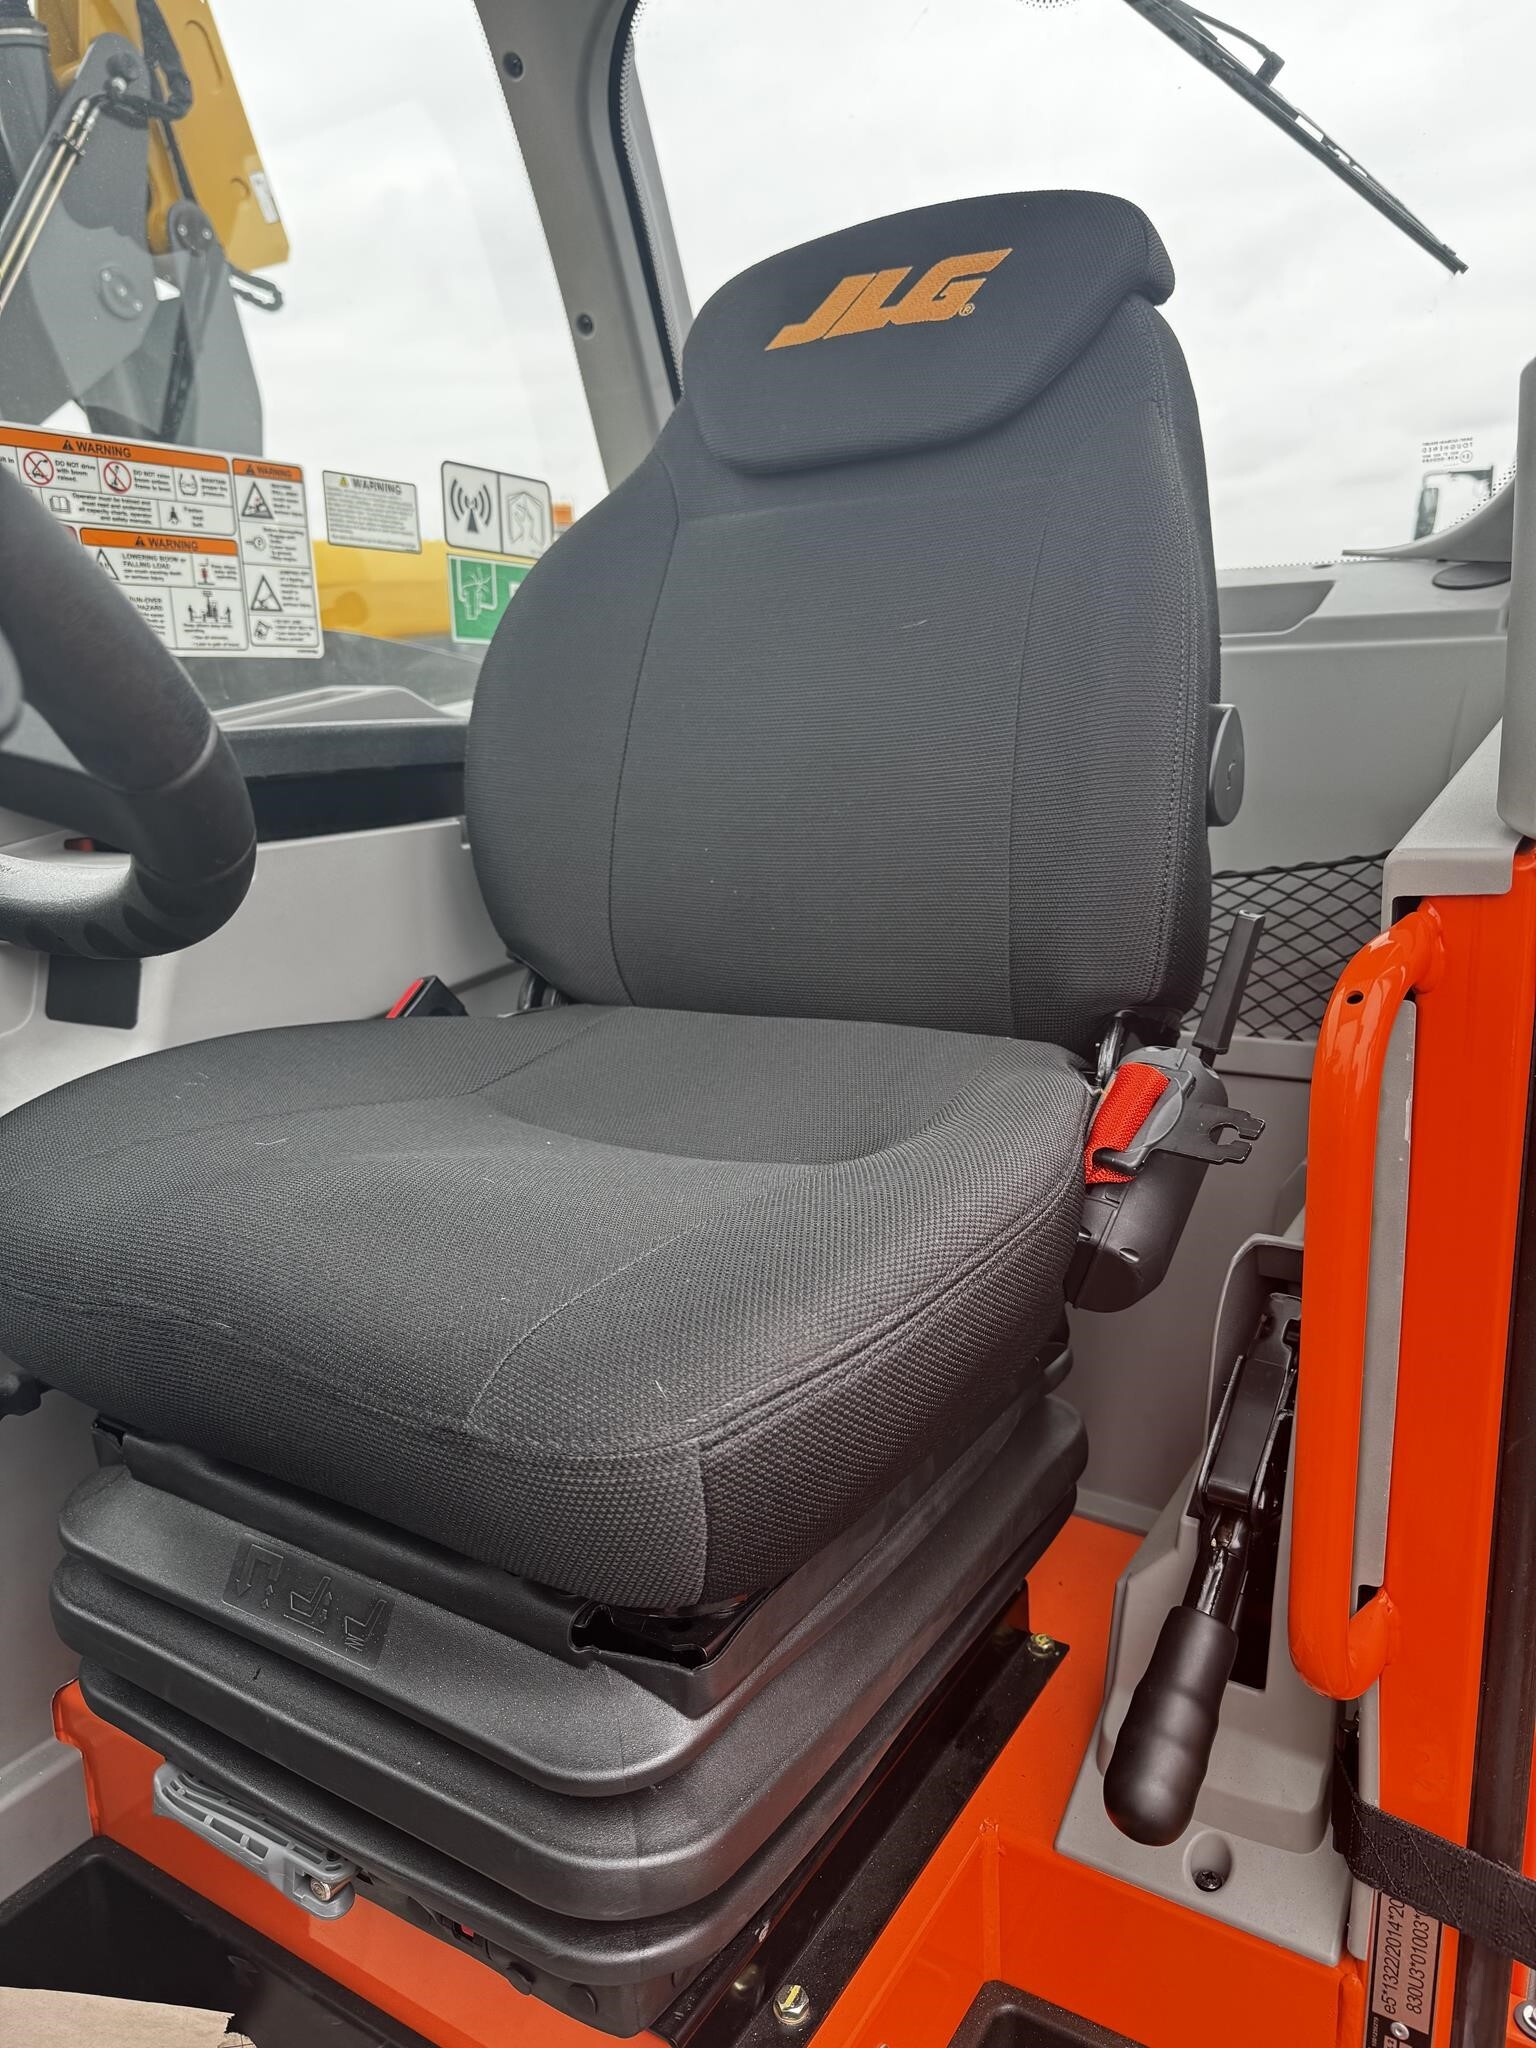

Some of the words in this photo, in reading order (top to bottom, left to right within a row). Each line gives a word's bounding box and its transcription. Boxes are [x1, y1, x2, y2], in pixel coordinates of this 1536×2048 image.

[764, 248, 1013, 351] JLG
[76, 440, 132, 459] WARNING
[352, 478, 402, 495] WARNING
[148, 537, 199, 551] WARNING
